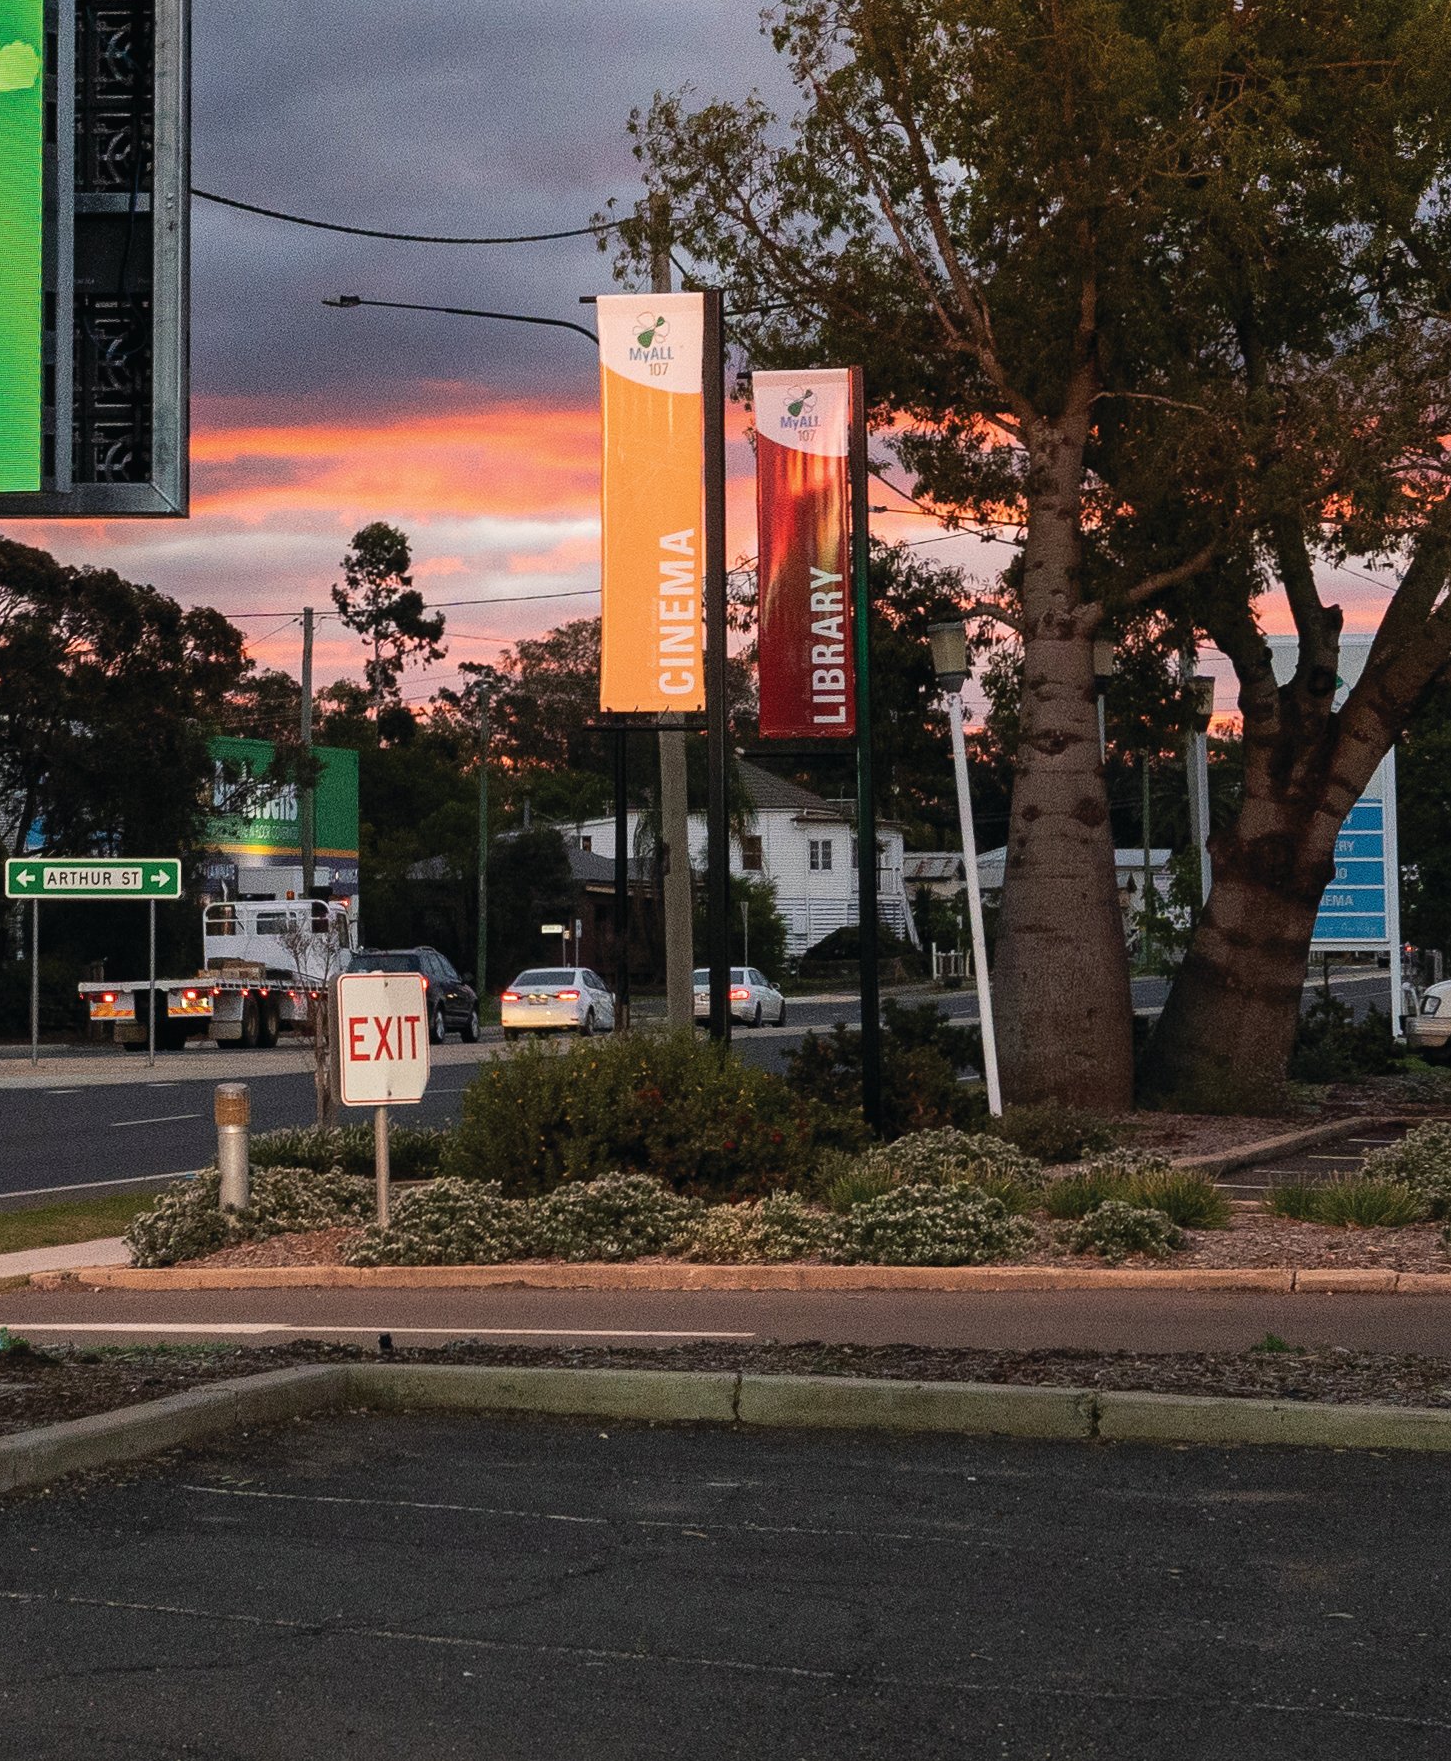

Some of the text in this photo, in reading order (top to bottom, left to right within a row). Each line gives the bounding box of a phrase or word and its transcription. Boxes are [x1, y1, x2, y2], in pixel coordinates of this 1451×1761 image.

[629, 347, 674, 363] MyALL
[649, 363, 669, 376] 107
[780, 415, 821, 431] MyALL
[798, 429, 816, 442] 107
[658, 527, 695, 696] CINEMA
[809, 566, 847, 725] LIBRARY
[47, 871, 139, 886] ARTHUR ST
[348, 1015, 420, 1061] EXIT
